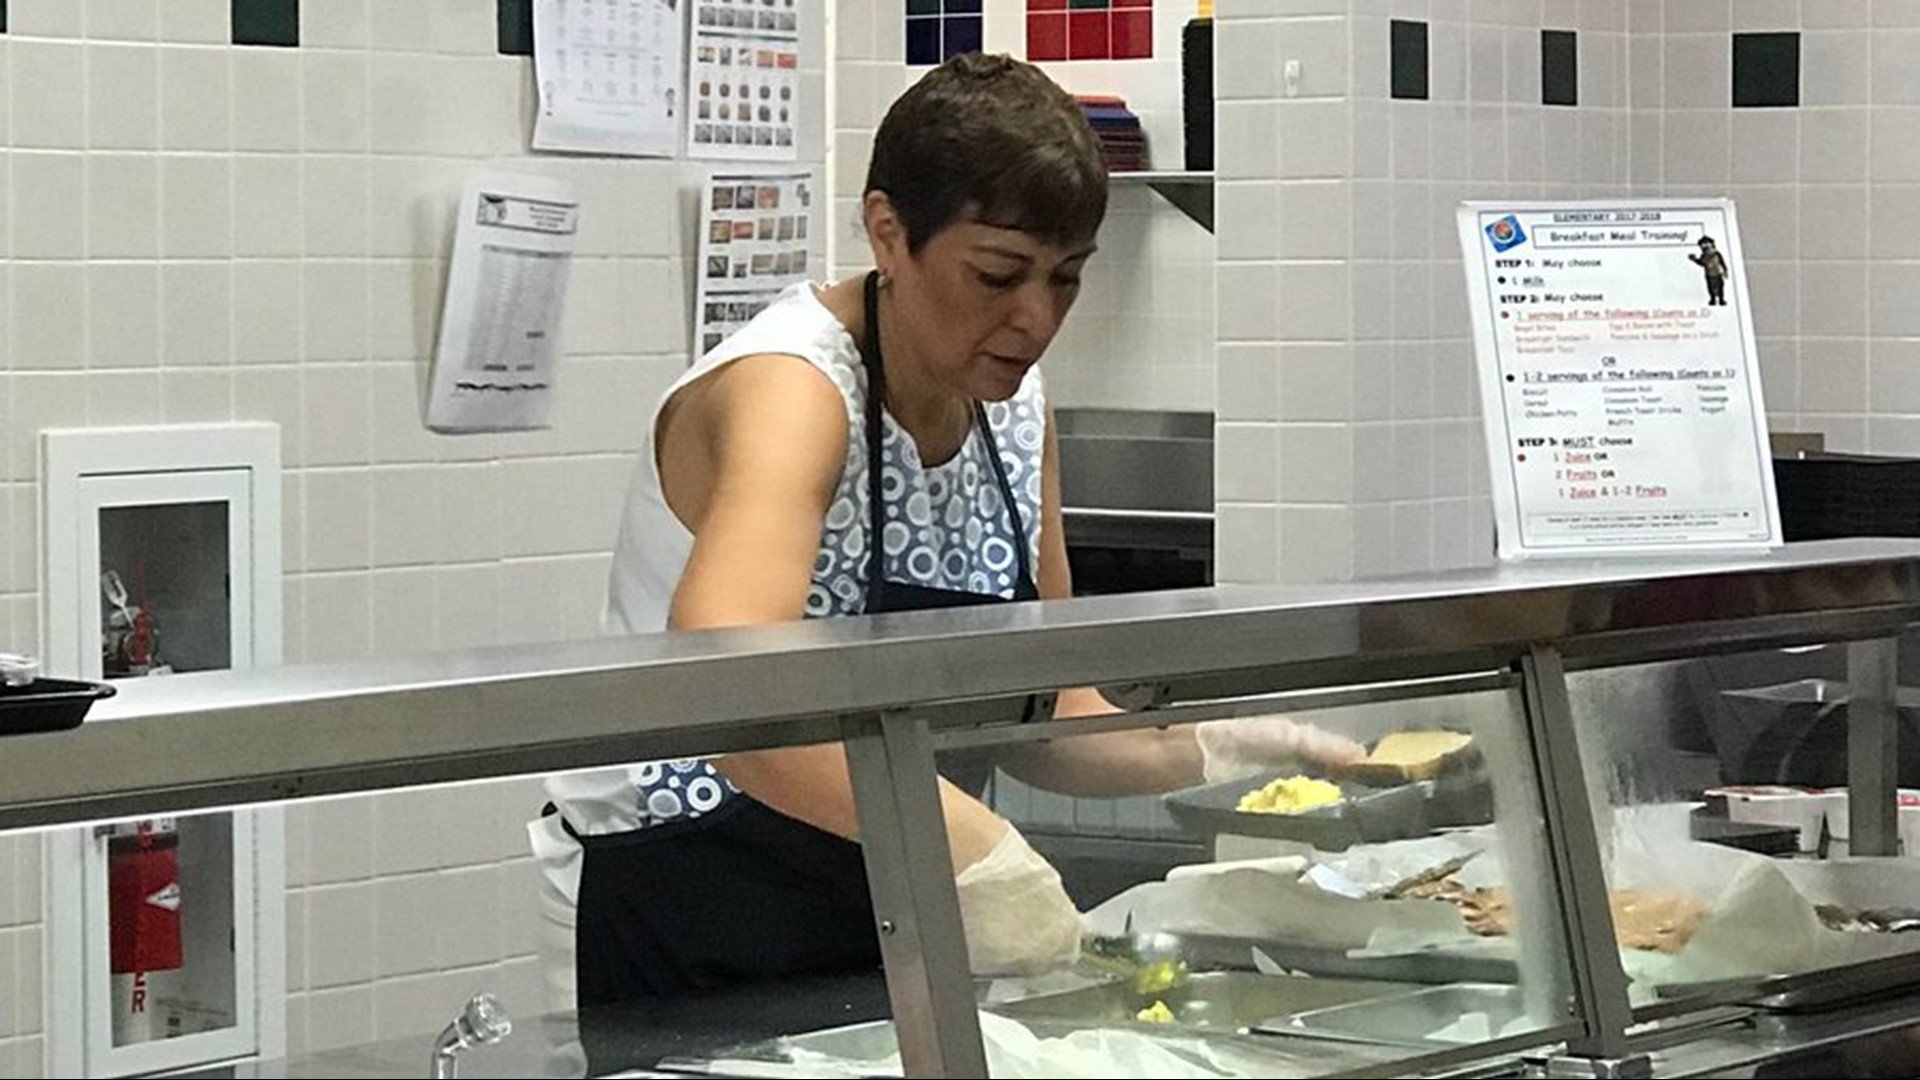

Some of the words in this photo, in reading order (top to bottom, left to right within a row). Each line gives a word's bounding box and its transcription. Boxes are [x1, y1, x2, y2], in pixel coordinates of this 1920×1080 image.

[1550, 231, 1605, 242] Breakfast
[1610, 230, 1636, 241] Meal
[1494, 259, 1522, 268] STEP
[1542, 259, 1563, 270] May
[1567, 259, 1602, 268] choose
[1523, 276, 1544, 287] Milk
[1500, 294, 1527, 304] STEP
[1544, 293, 1566, 304] May
[1569, 292, 1604, 302] choose
[1528, 312, 1564, 322] serving
[1567, 309, 1578, 320] of
[1583, 309, 1599, 318] the
[1604, 308, 1649, 319] following
[1602, 356, 1616, 367] OR
[1547, 373, 1588, 383] servings
[1592, 370, 1602, 380] of
[1608, 370, 1624, 380] the
[1629, 369, 1673, 380] following
[1518, 438, 1545, 447] STEP
[1563, 436, 1596, 448] MUST
[1599, 437, 1633, 446] choose
[1565, 452, 1591, 464] Juice
[1594, 452, 1608, 461] OR
[1566, 469, 1597, 481] Fruits
[1601, 469, 1615, 478] OR
[1569, 487, 1597, 499] Juice
[1635, 485, 1668, 497] Fruits
